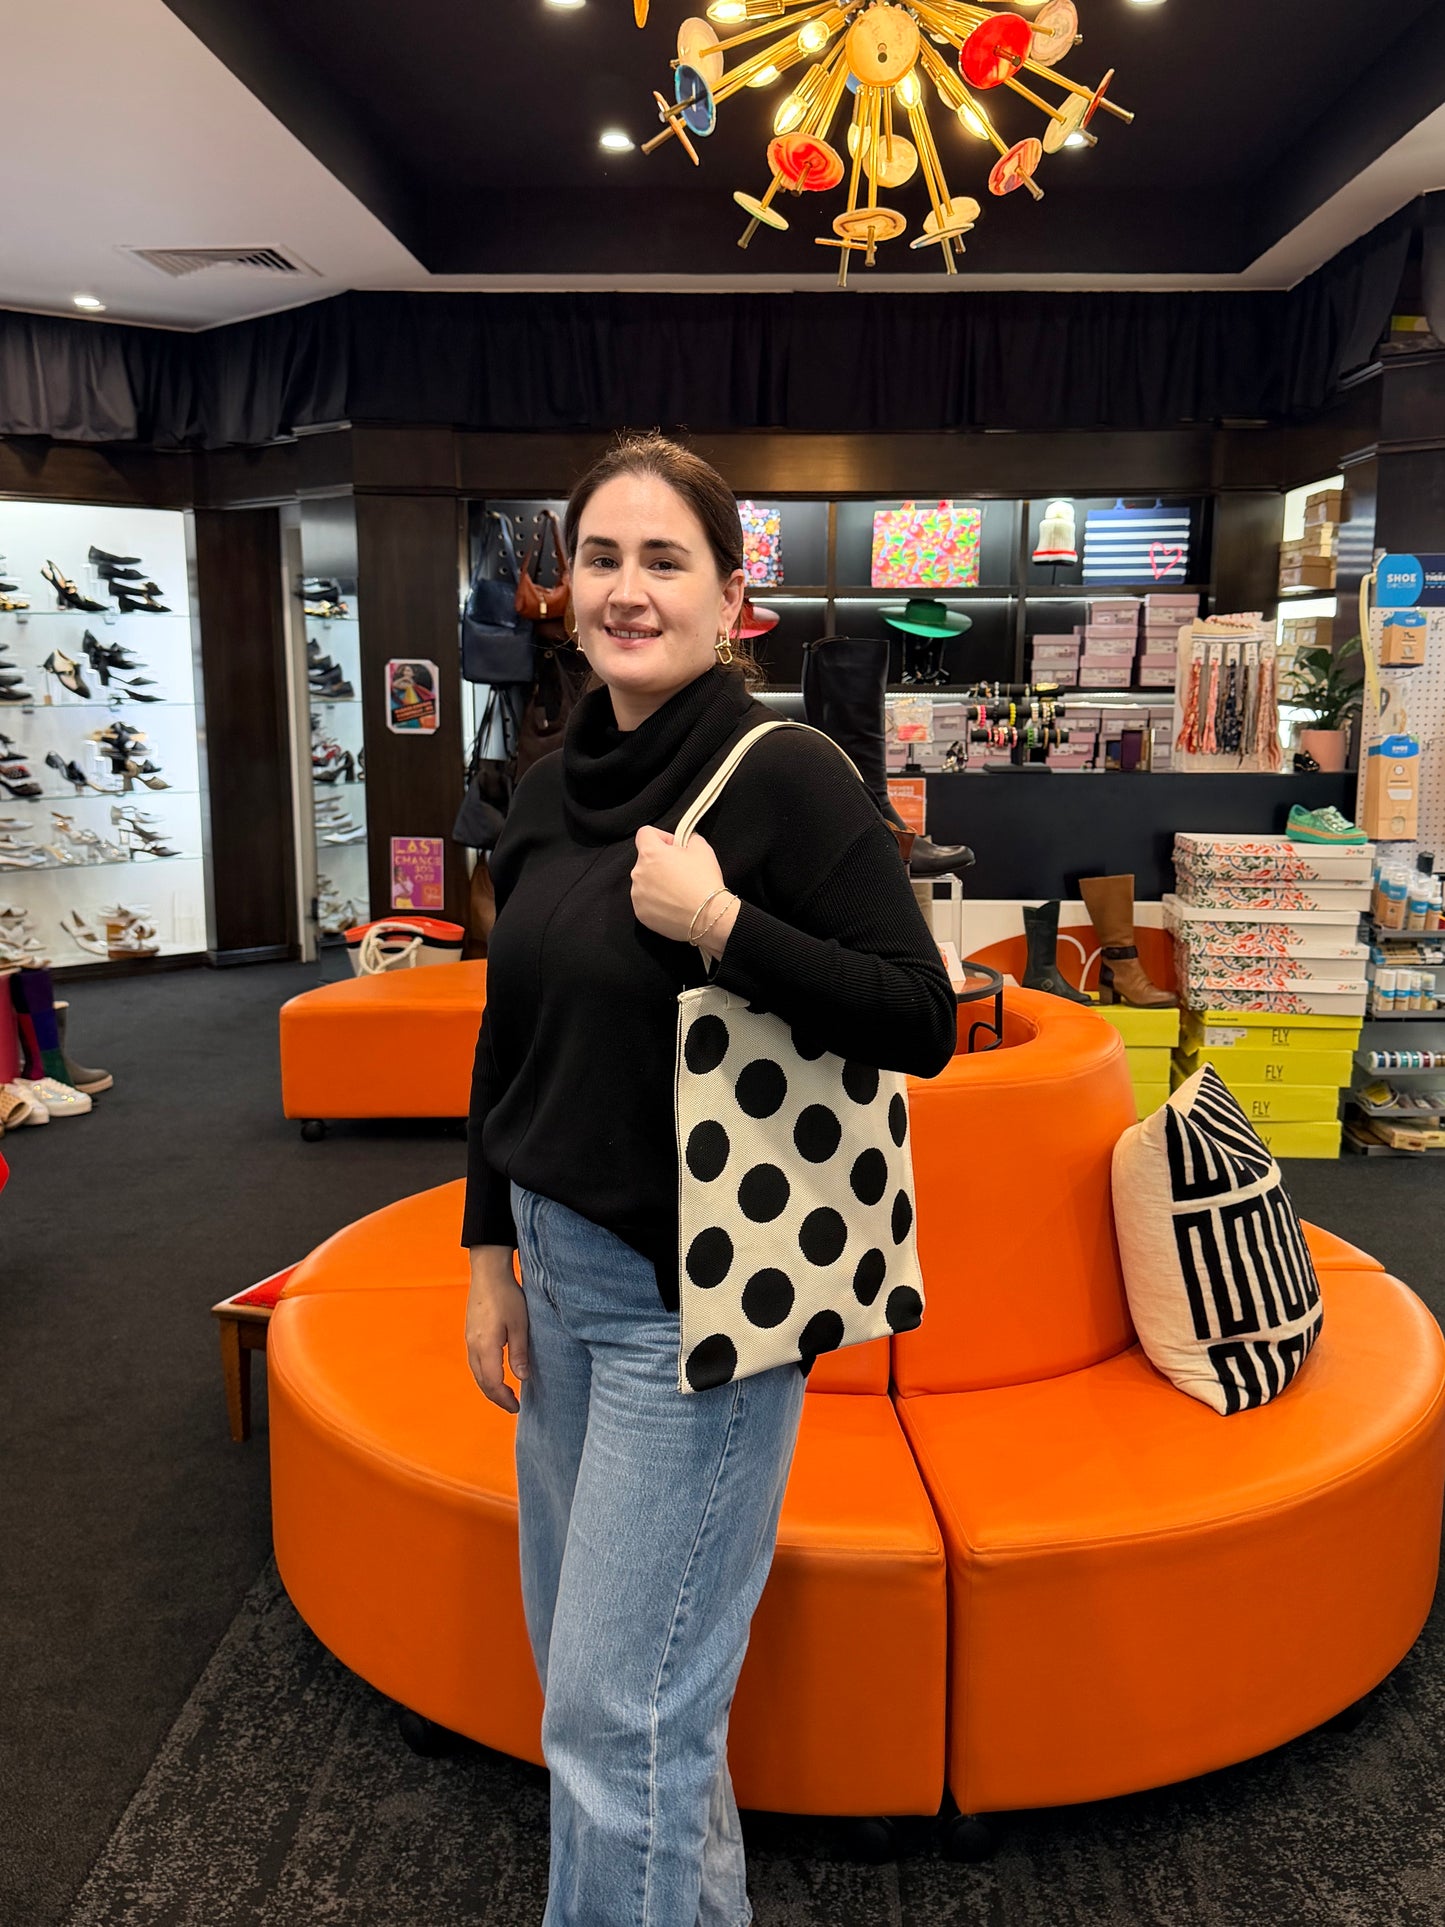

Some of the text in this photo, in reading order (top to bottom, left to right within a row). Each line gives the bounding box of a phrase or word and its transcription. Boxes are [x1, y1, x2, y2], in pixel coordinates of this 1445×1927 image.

[1386, 573, 1417, 583] SHOE
[394, 840, 441, 855] LAST
[395, 856, 441, 866] CHANCE
[1272, 1028, 1290, 1043] FLY
[1265, 1064, 1283, 1079] FLY
[1252, 1101, 1270, 1115] FLY
